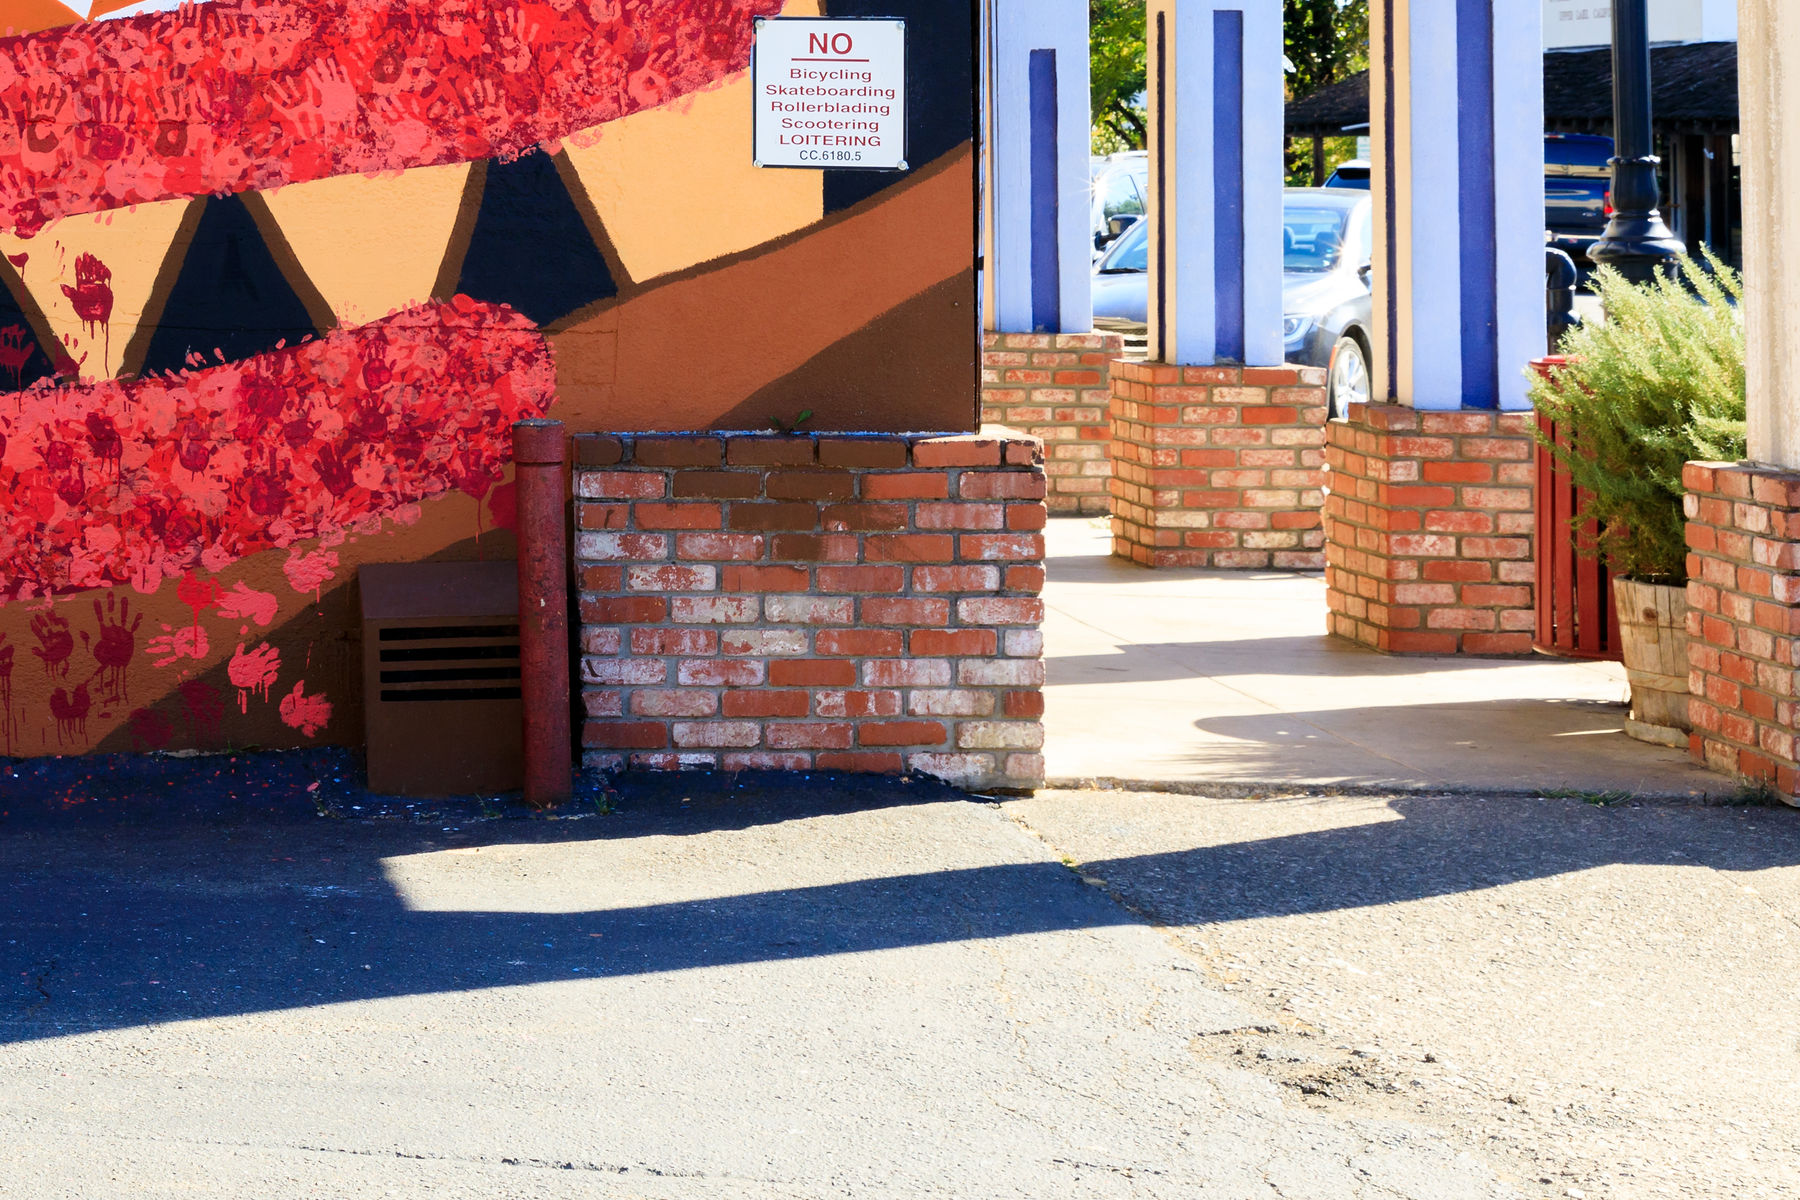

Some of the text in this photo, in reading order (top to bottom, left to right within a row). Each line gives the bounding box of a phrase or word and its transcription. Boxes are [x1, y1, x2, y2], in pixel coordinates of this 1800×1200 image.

[809, 32, 853, 55] NO
[790, 68, 872, 83] Bicycling
[766, 84, 895, 100] Skateboarding
[771, 101, 890, 117] Rollerblading
[781, 118, 879, 133] Scootering
[780, 134, 881, 147] LOITERING
[799, 150, 862, 161] CC.6180.5
